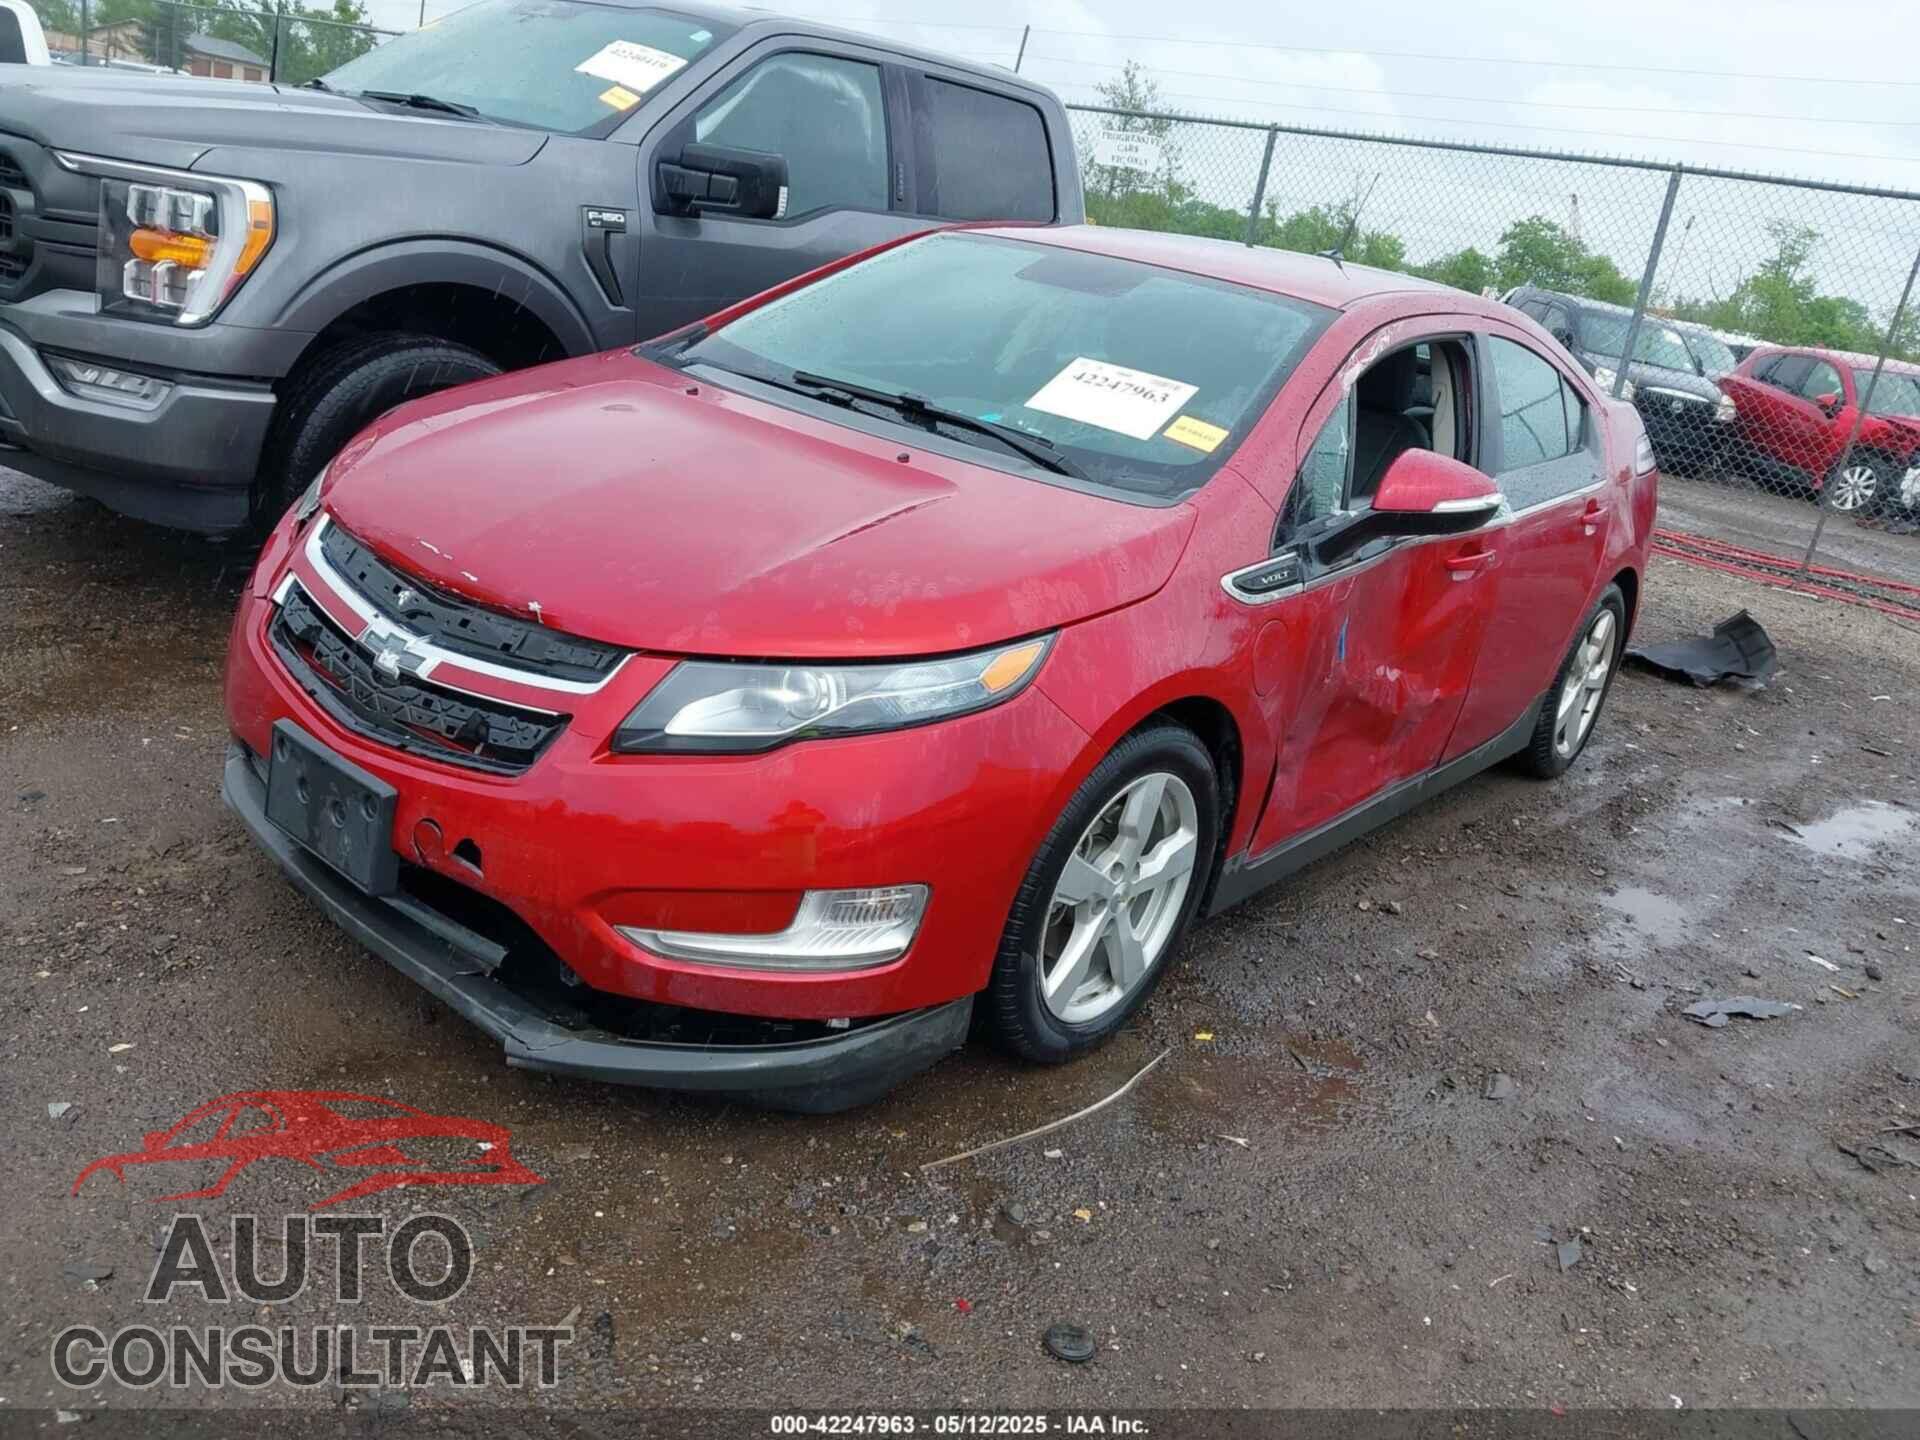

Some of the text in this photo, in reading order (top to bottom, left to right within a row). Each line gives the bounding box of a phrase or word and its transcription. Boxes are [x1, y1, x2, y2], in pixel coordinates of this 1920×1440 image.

[588, 211, 625, 223] F-150
[1073, 371, 1169, 403] 42247963
[1261, 571, 1289, 584] VOLT
